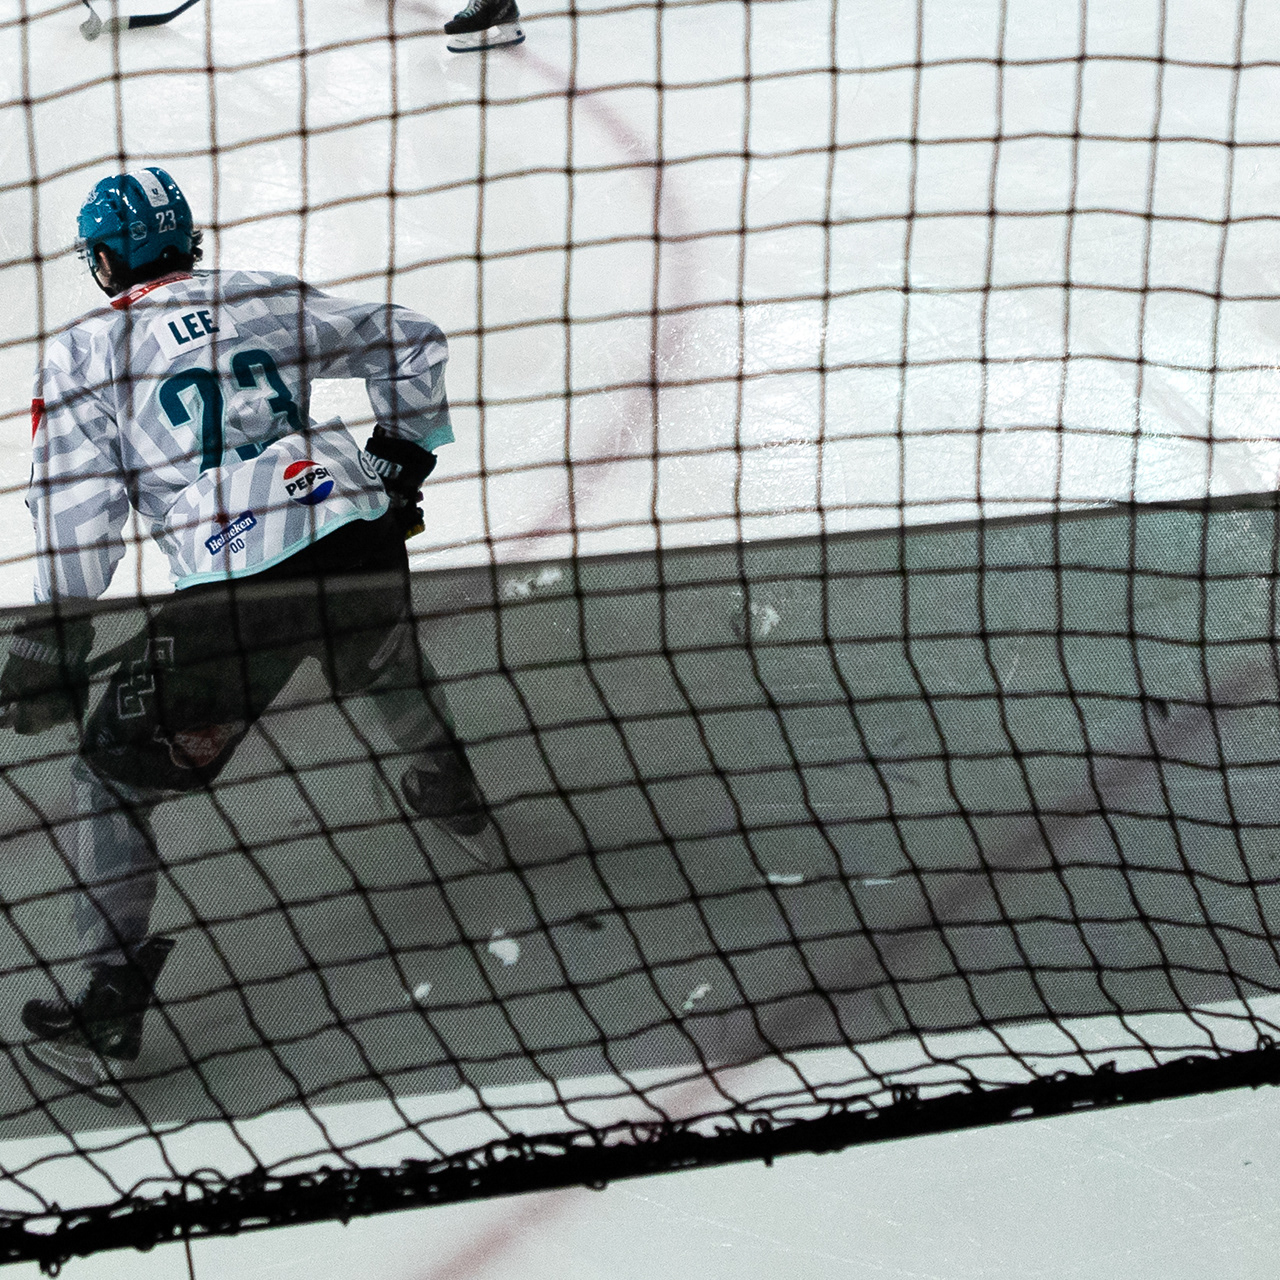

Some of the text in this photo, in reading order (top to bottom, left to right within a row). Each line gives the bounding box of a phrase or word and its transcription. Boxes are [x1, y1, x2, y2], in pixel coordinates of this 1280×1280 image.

[155, 209, 177, 234] 23
[168, 309, 220, 346] LEE
[285, 466, 332, 497] PEPSI
[207, 515, 255, 552] Heineken
